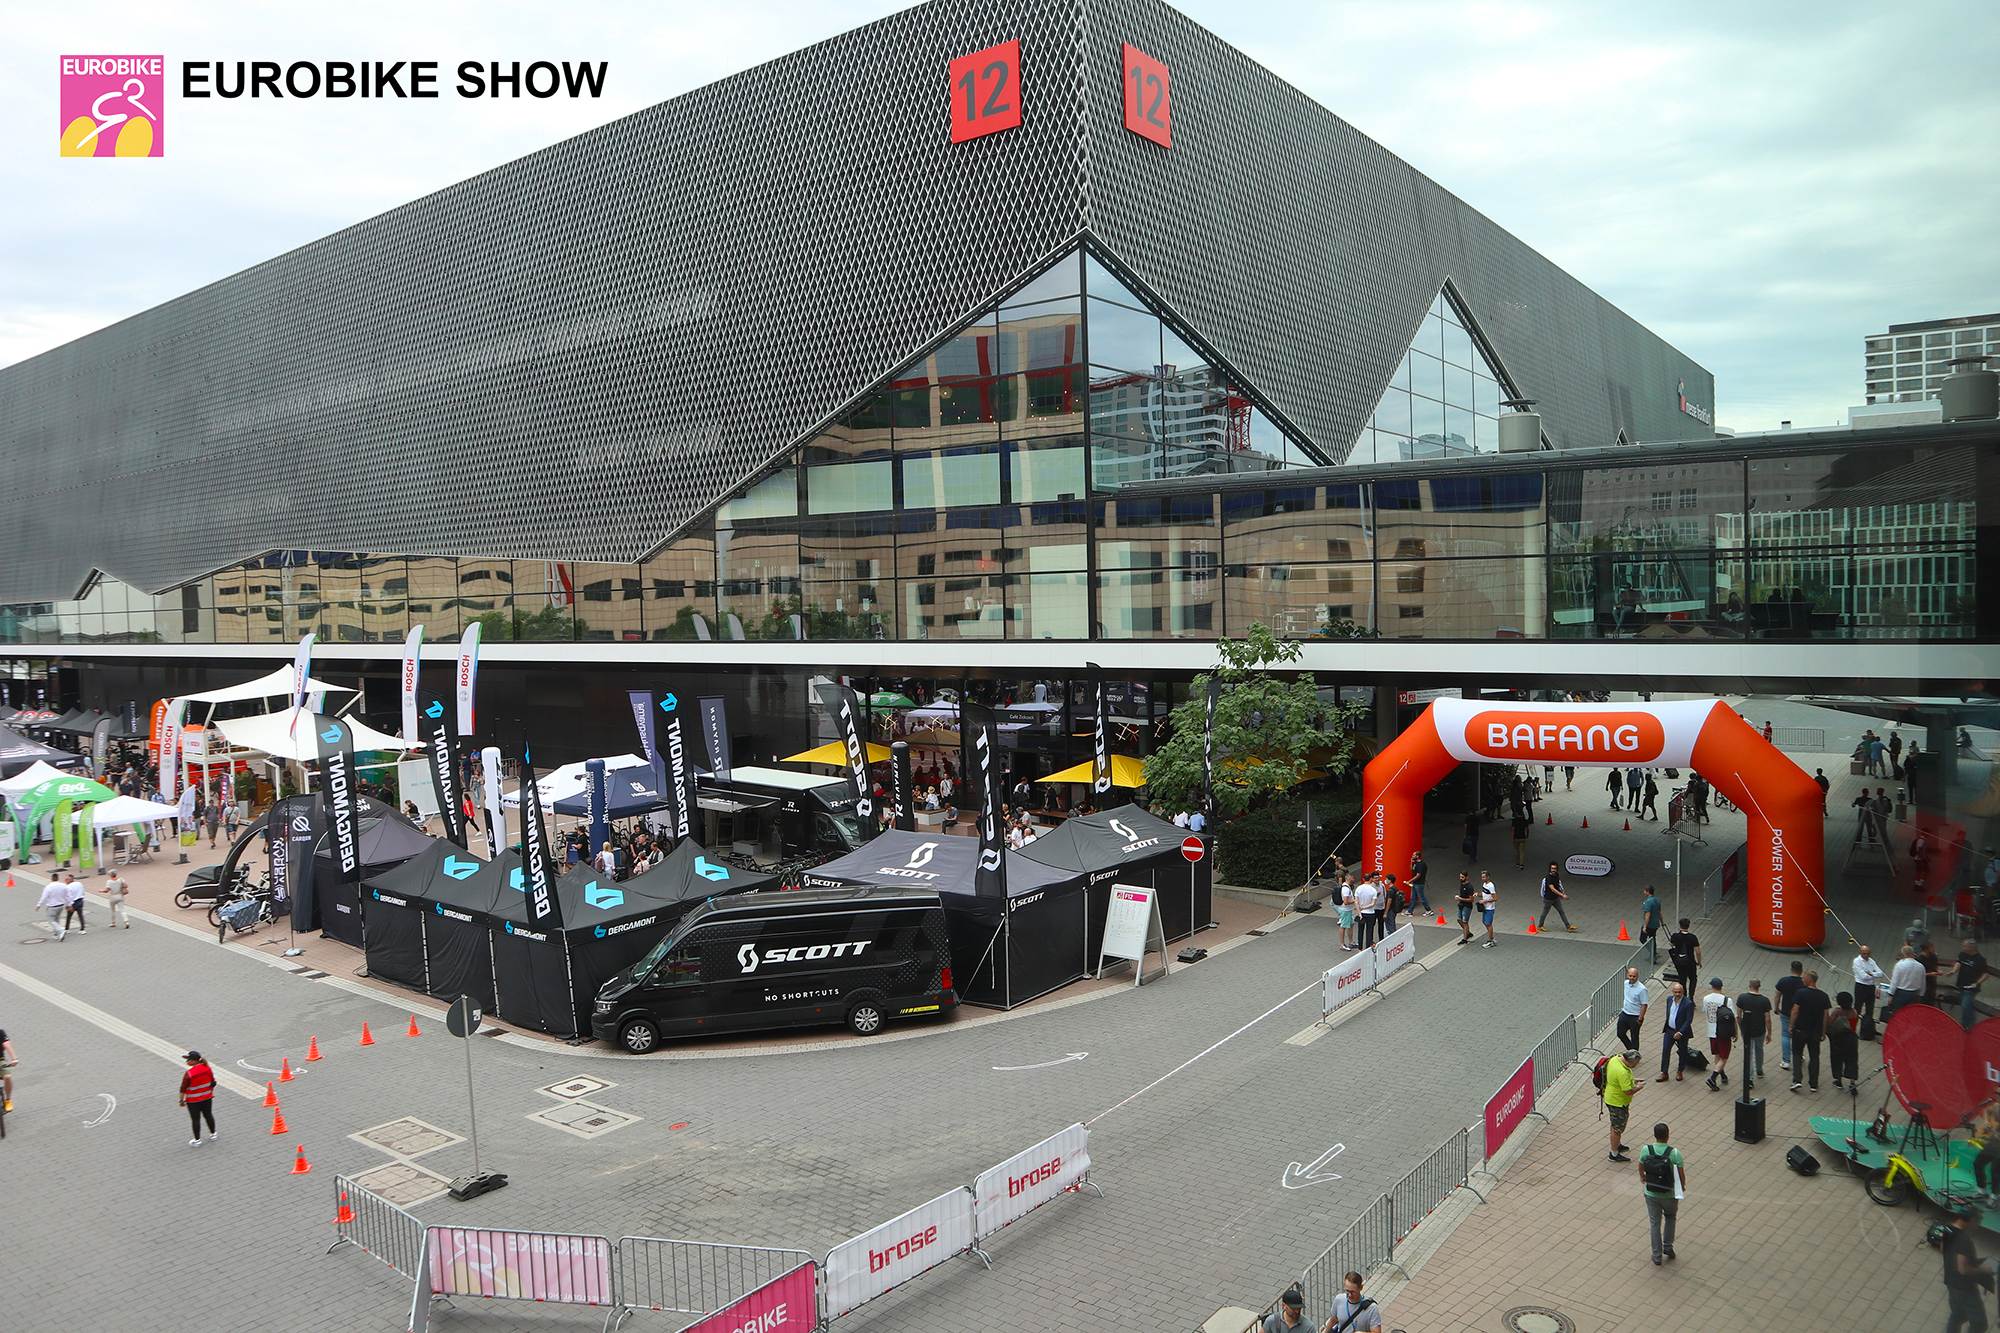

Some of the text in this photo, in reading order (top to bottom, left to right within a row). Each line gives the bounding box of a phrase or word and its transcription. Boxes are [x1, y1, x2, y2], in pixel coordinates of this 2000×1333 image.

[958, 60, 1010, 122] 12
[1130, 65, 1165, 129] 12
[405, 658, 414, 692] BOSCH
[461, 654, 470, 687] BOSCH
[1399, 693, 1407, 703] 12
[163, 725, 174, 755] BOSCH
[1487, 722, 1639, 751] BAFANG
[892, 754, 901, 801] RAYMON
[1375, 804, 1385, 841] POWER
[1121, 837, 1159, 854] SCOTT
[1374, 843, 1384, 872] YOUR
[810, 879, 843, 888] SCOTT
[876, 867, 941, 881] SCOTT
[1095, 869, 1120, 882] SCOTT
[1771, 828, 1783, 936] POWER YOUR LIFE
[380, 894, 407, 907] BERGAMONT
[1016, 892, 1045, 908] SCOTT
[444, 909, 473, 923] BERGAMONT
[608, 916, 657, 936] BERGAMONT
[514, 927, 547, 942] BERGAMONT
[761, 940, 872, 964] SCOTT
[1385, 941, 1405, 962] brose
[1337, 968, 1362, 990] brose
[782, 988, 840, 1000] SHORTCUTS
[1496, 1084, 1526, 1128] EUROBIKE
[1008, 1156, 1061, 1198] brose
[869, 1225, 938, 1273] brose
